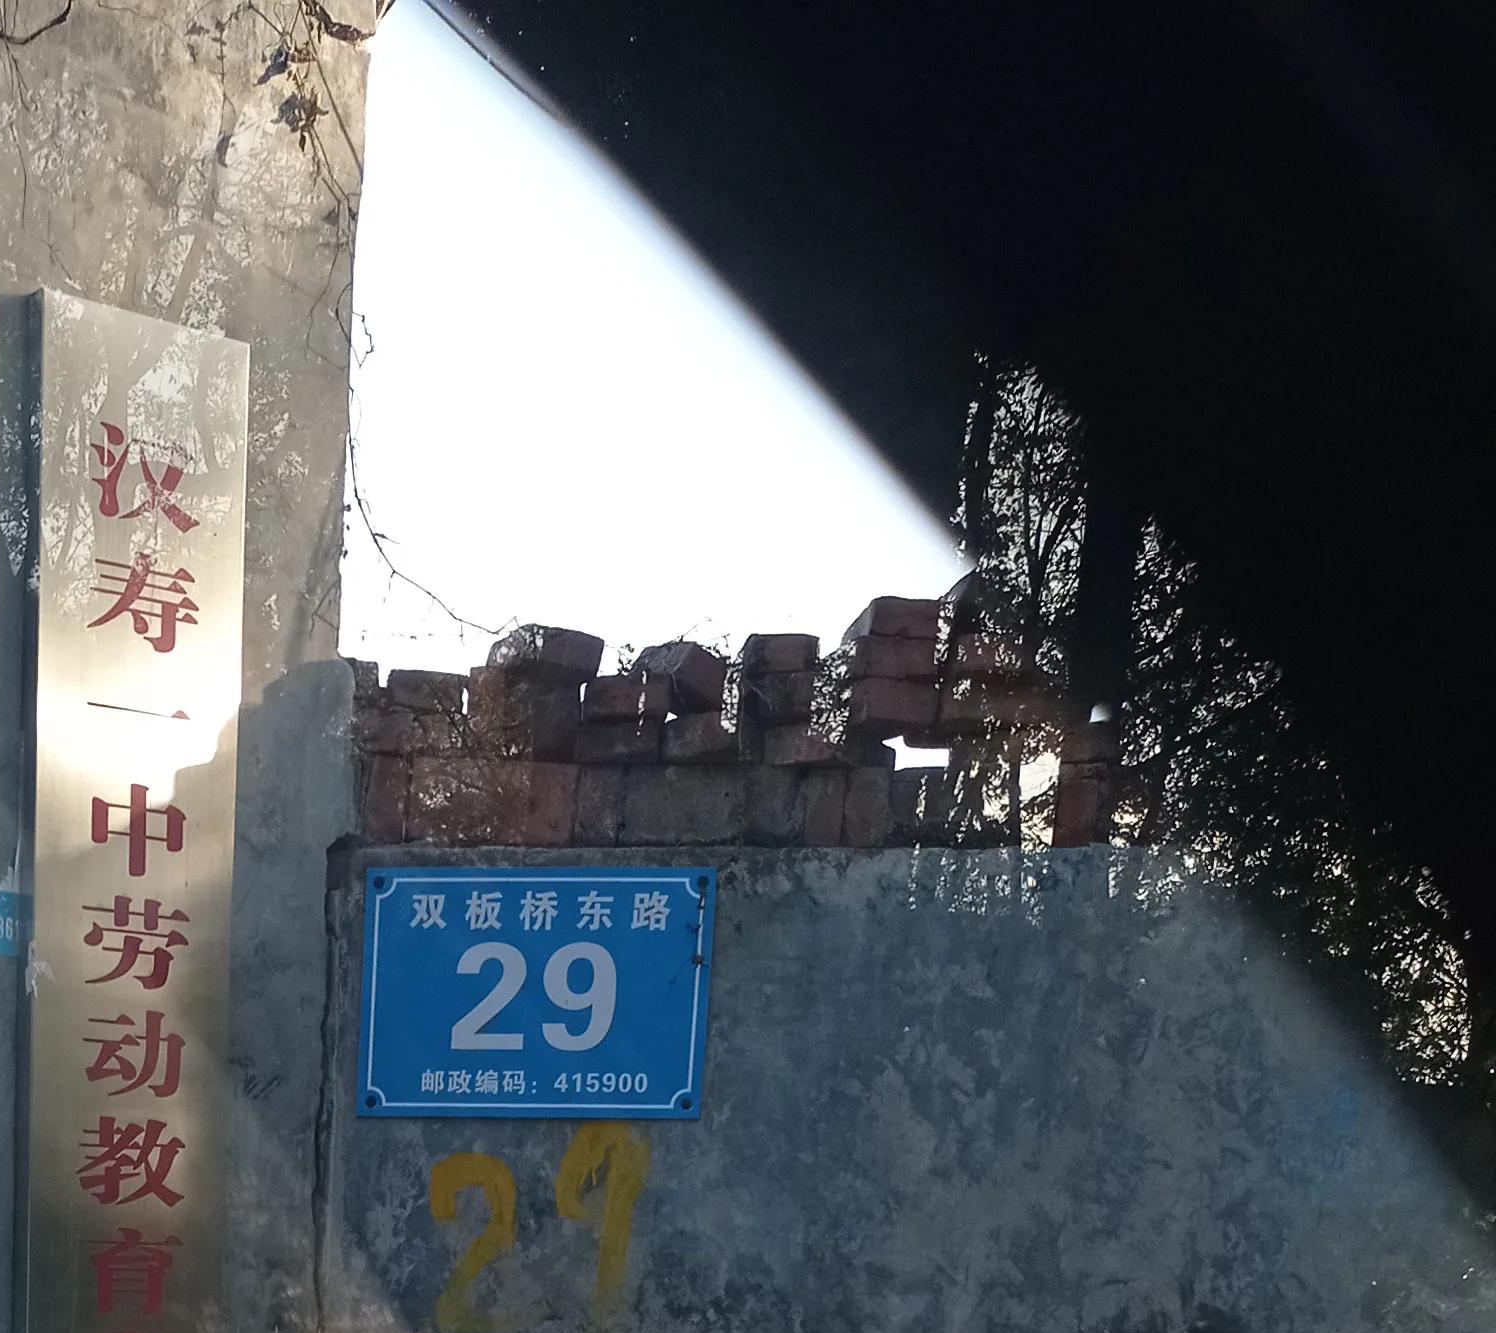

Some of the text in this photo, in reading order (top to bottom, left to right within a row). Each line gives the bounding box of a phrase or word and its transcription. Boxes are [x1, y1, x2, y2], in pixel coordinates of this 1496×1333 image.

[409, 890, 671, 931] 双板桥东路
[451, 941, 617, 1051] 29
